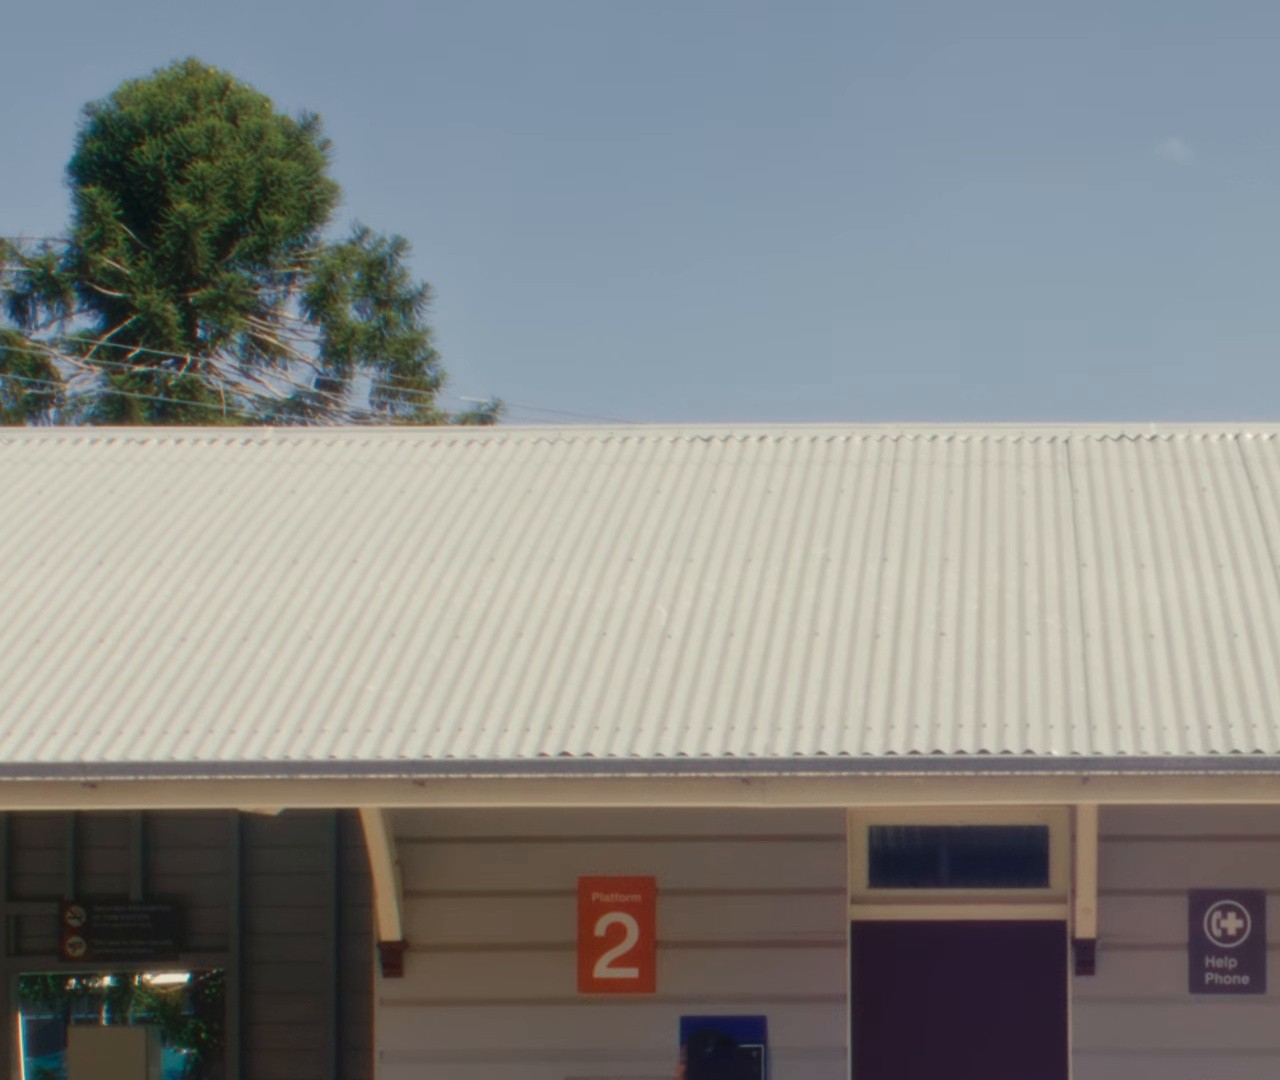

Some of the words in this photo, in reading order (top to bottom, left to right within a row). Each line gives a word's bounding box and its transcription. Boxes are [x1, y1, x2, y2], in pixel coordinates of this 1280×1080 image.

[592, 891, 642, 903] Platform
[592, 911, 640, 979] 2
[1204, 956, 1238, 970] Help
[1204, 972, 1250, 985] Phone
